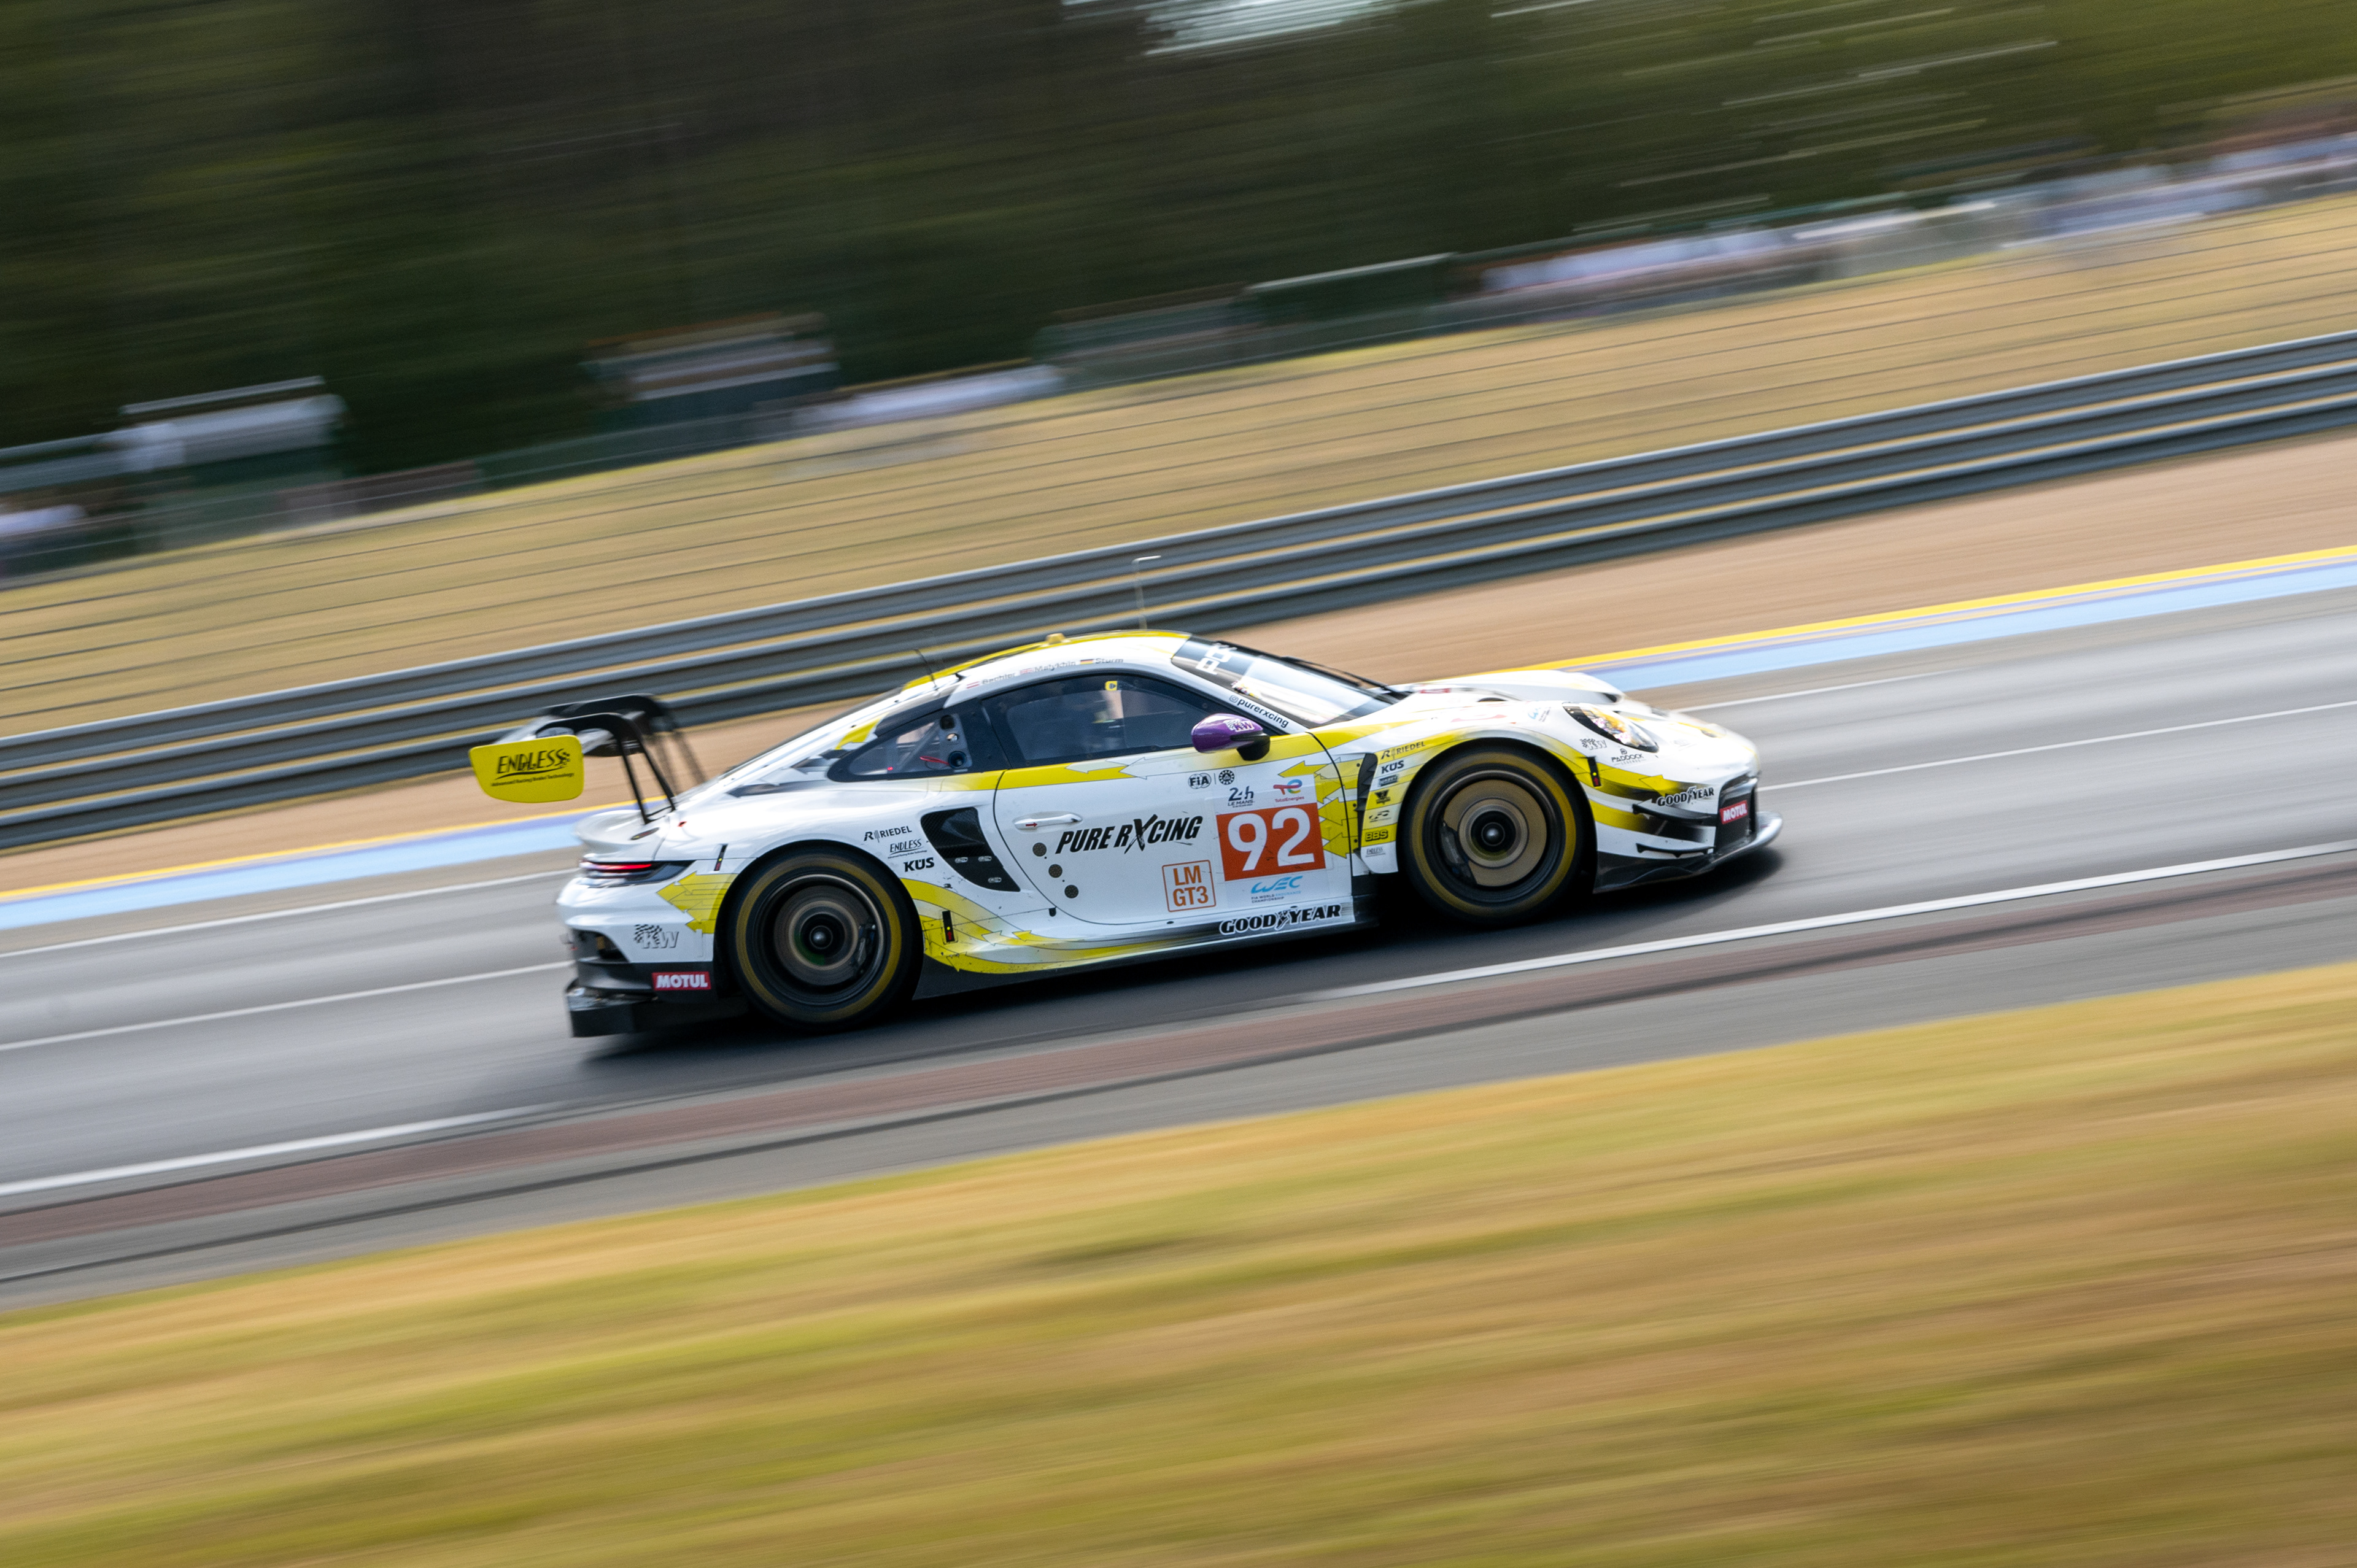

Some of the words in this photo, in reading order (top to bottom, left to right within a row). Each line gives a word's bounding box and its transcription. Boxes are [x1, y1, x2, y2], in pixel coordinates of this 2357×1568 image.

[1237, 698, 1289, 728] purerxcing
[1396, 741, 1425, 755] RIEDEL
[497, 748, 565, 774] ENDLESS
[1382, 760, 1404, 774] KÜS
[1611, 754, 1644, 762] PADDOCK
[1657, 787, 1714, 806] GOODYEAR
[1723, 803, 1747, 822] MOTUL
[879, 826, 912, 838] RIEDEL
[1055, 825, 1115, 854] PURE
[1228, 808, 1315, 871] 92
[1365, 830, 1388, 841] BBS
[890, 838, 921, 852] ENDLESS
[904, 857, 934, 872] KÜS
[1173, 865, 1202, 886] LM
[1251, 876, 1303, 894] WEC
[1172, 886, 1209, 907] GT3
[1220, 905, 1341, 933] GOODYEAR
[642, 931, 679, 949] KW
[656, 975, 708, 988] MOTUL
